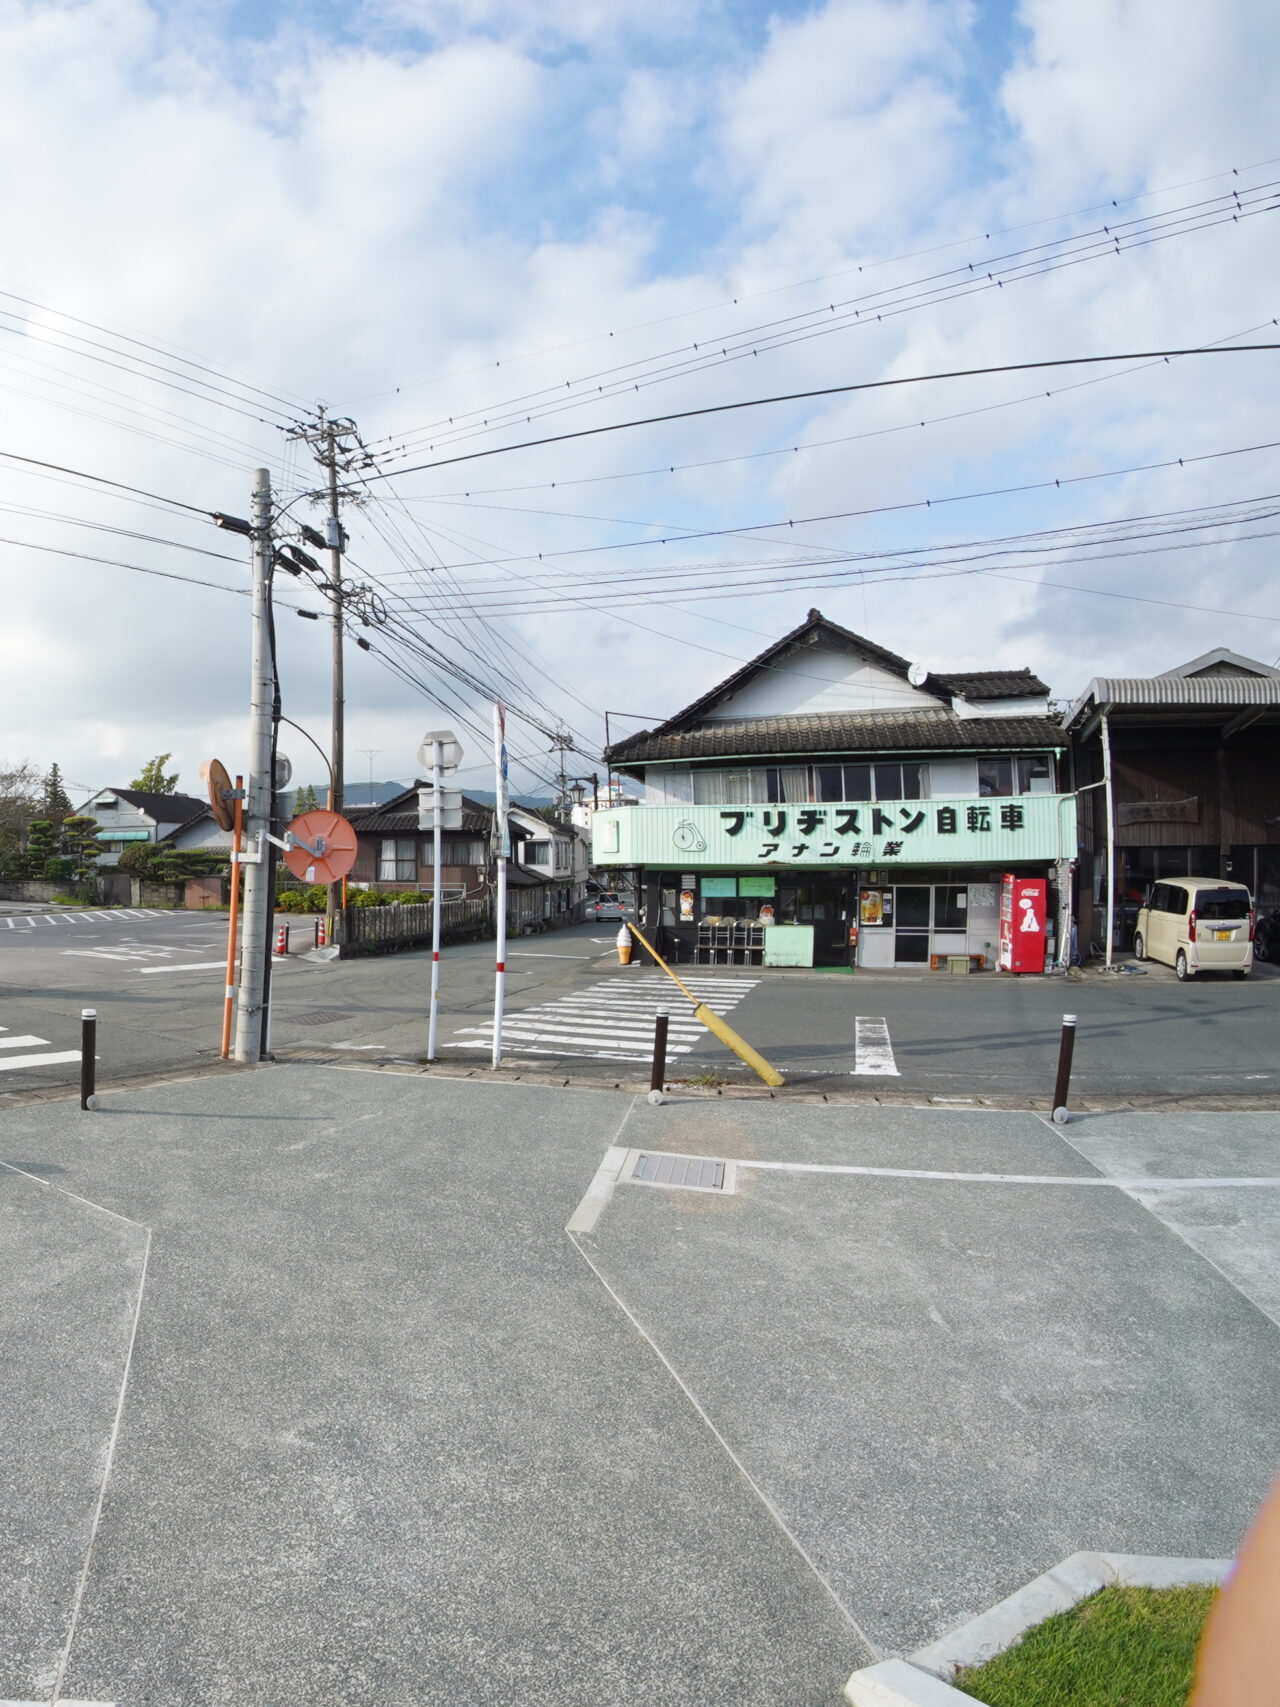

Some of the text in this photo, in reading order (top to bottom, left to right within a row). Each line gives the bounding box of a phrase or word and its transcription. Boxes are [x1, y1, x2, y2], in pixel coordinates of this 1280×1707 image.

[720, 804, 1024, 837] ブリヂストン自転車
[758, 841, 904, 858] アナン輪業
